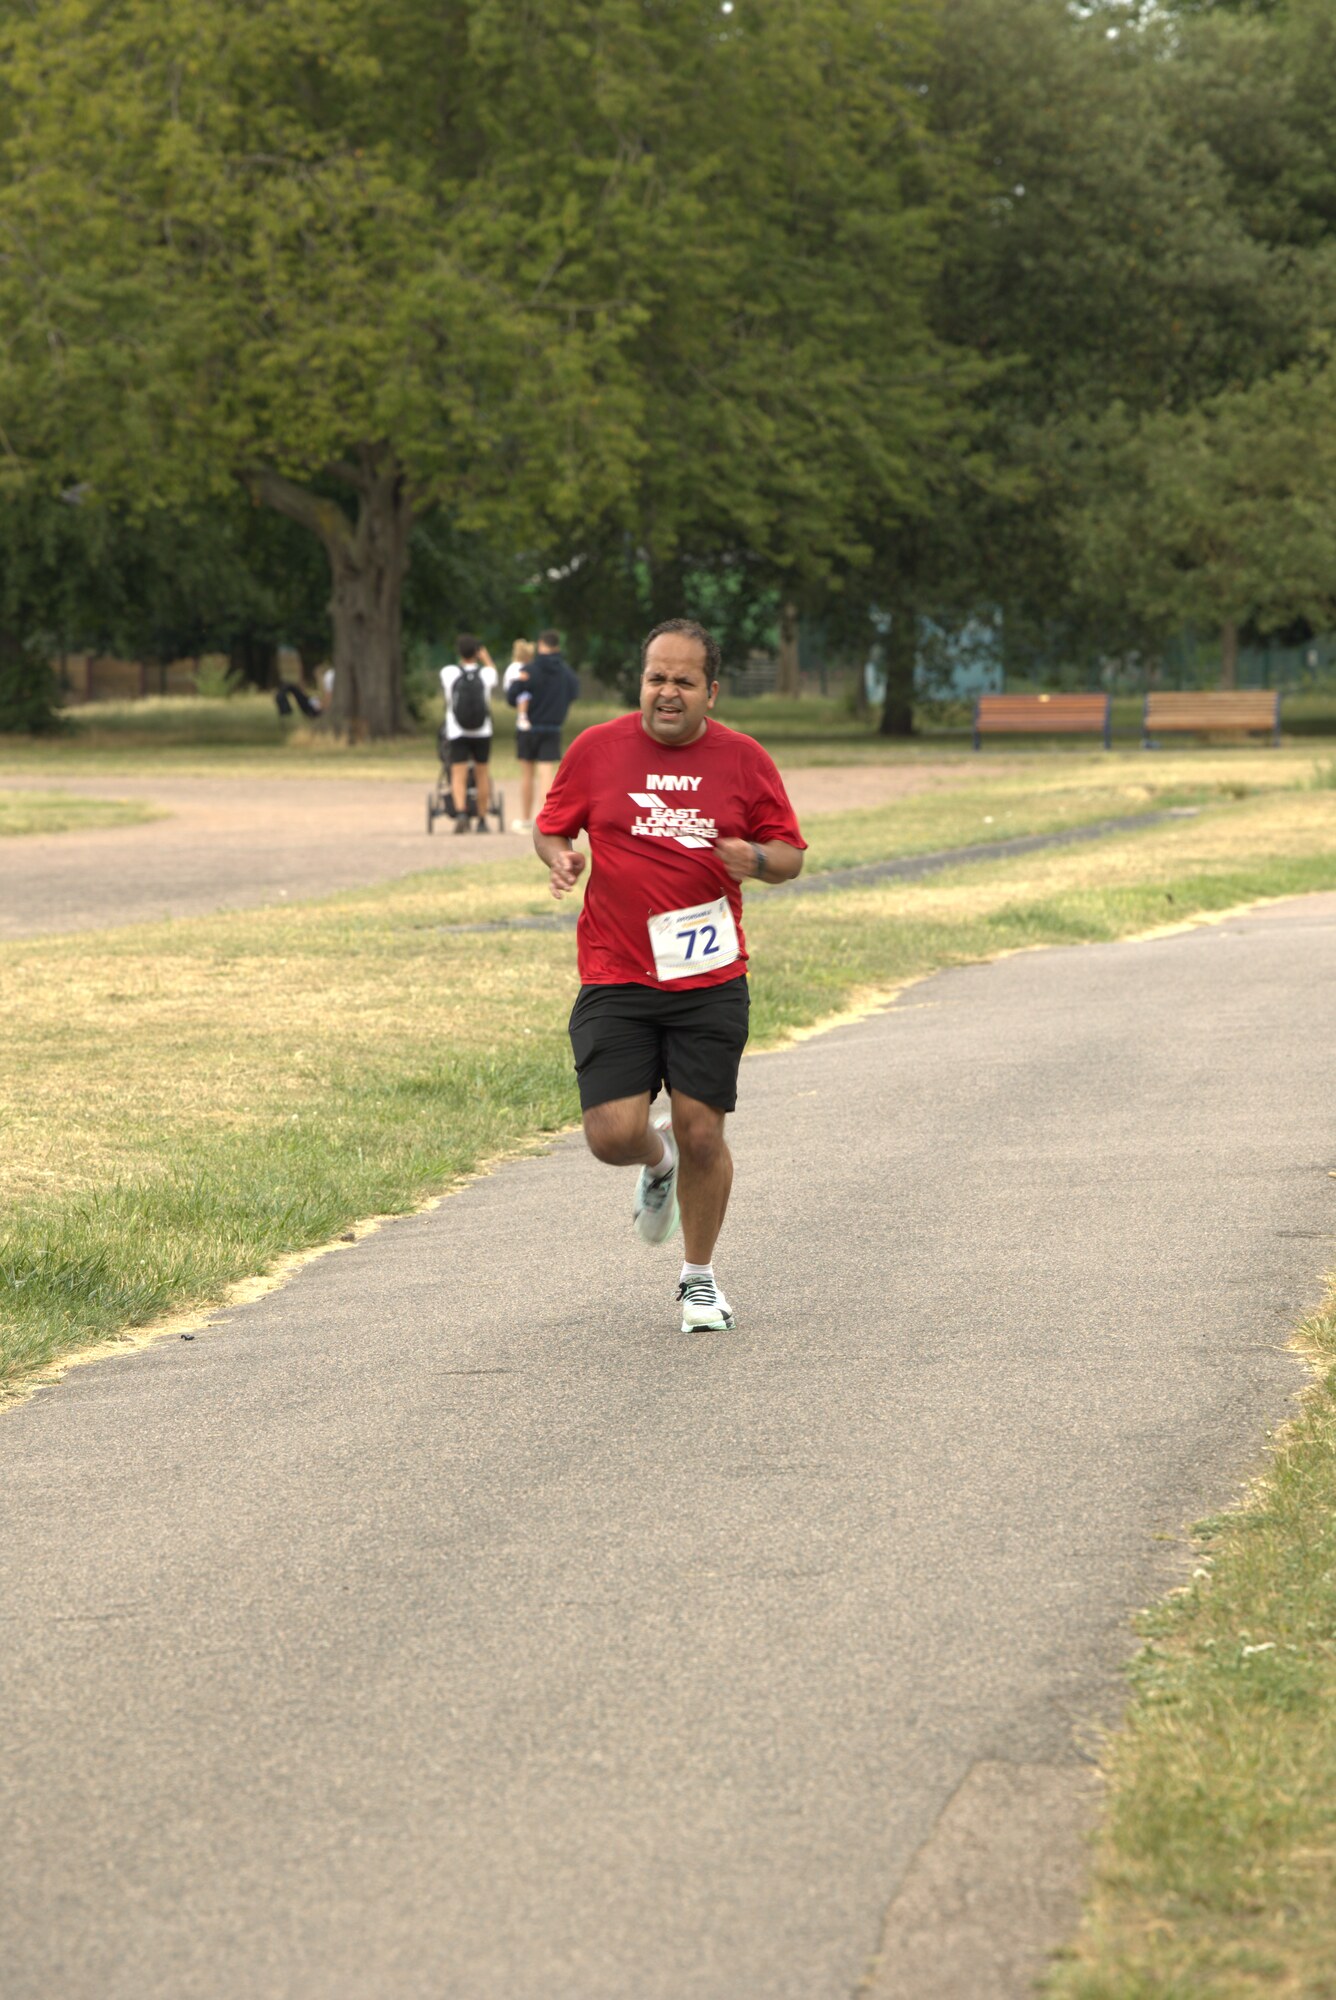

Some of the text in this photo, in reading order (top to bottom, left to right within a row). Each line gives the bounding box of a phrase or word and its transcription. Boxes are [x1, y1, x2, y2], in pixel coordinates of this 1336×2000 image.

[646, 774, 703, 791] IMMY
[651, 808, 701, 818] EAST
[636, 816, 715, 828] LONDON
[676, 924, 720, 961] 72
